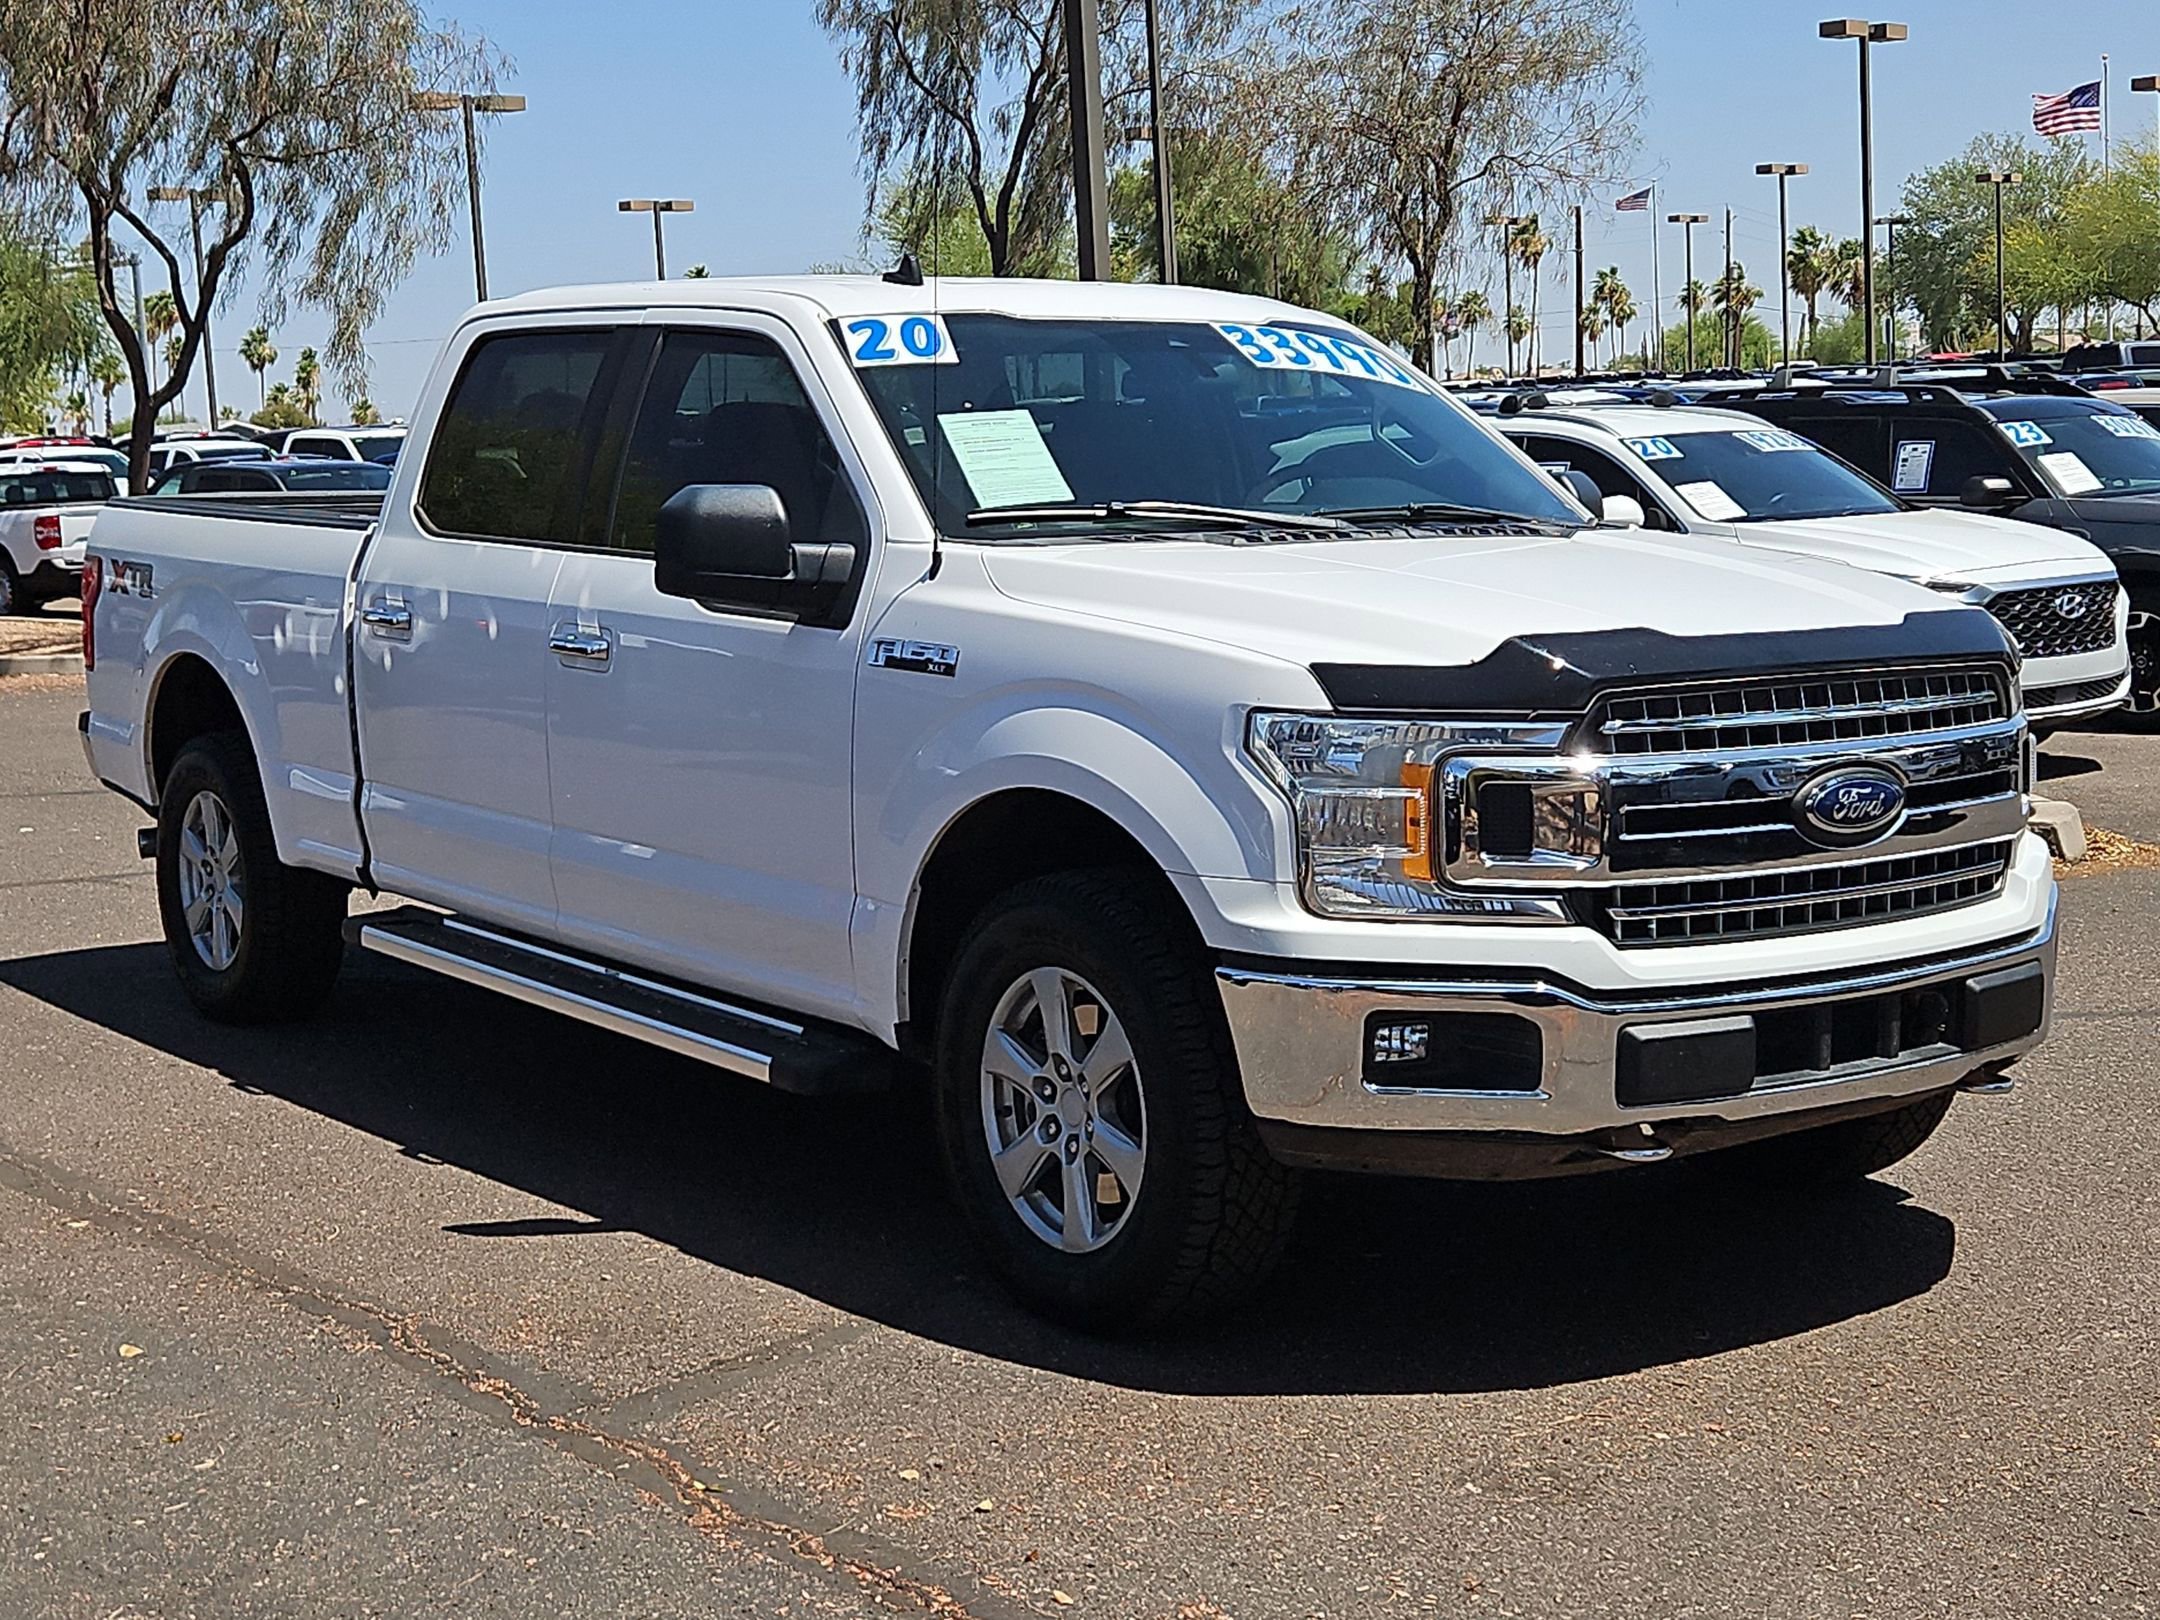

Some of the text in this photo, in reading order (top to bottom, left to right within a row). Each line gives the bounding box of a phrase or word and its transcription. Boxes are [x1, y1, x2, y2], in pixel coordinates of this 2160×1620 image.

[847, 317, 942, 361] 20
[1219, 324, 1412, 385] 33990
[1631, 437, 1674, 458] 20
[2004, 422, 2044, 444] 23
[108, 558, 155, 596] XTR
[1832, 786, 1886, 820] Ford
